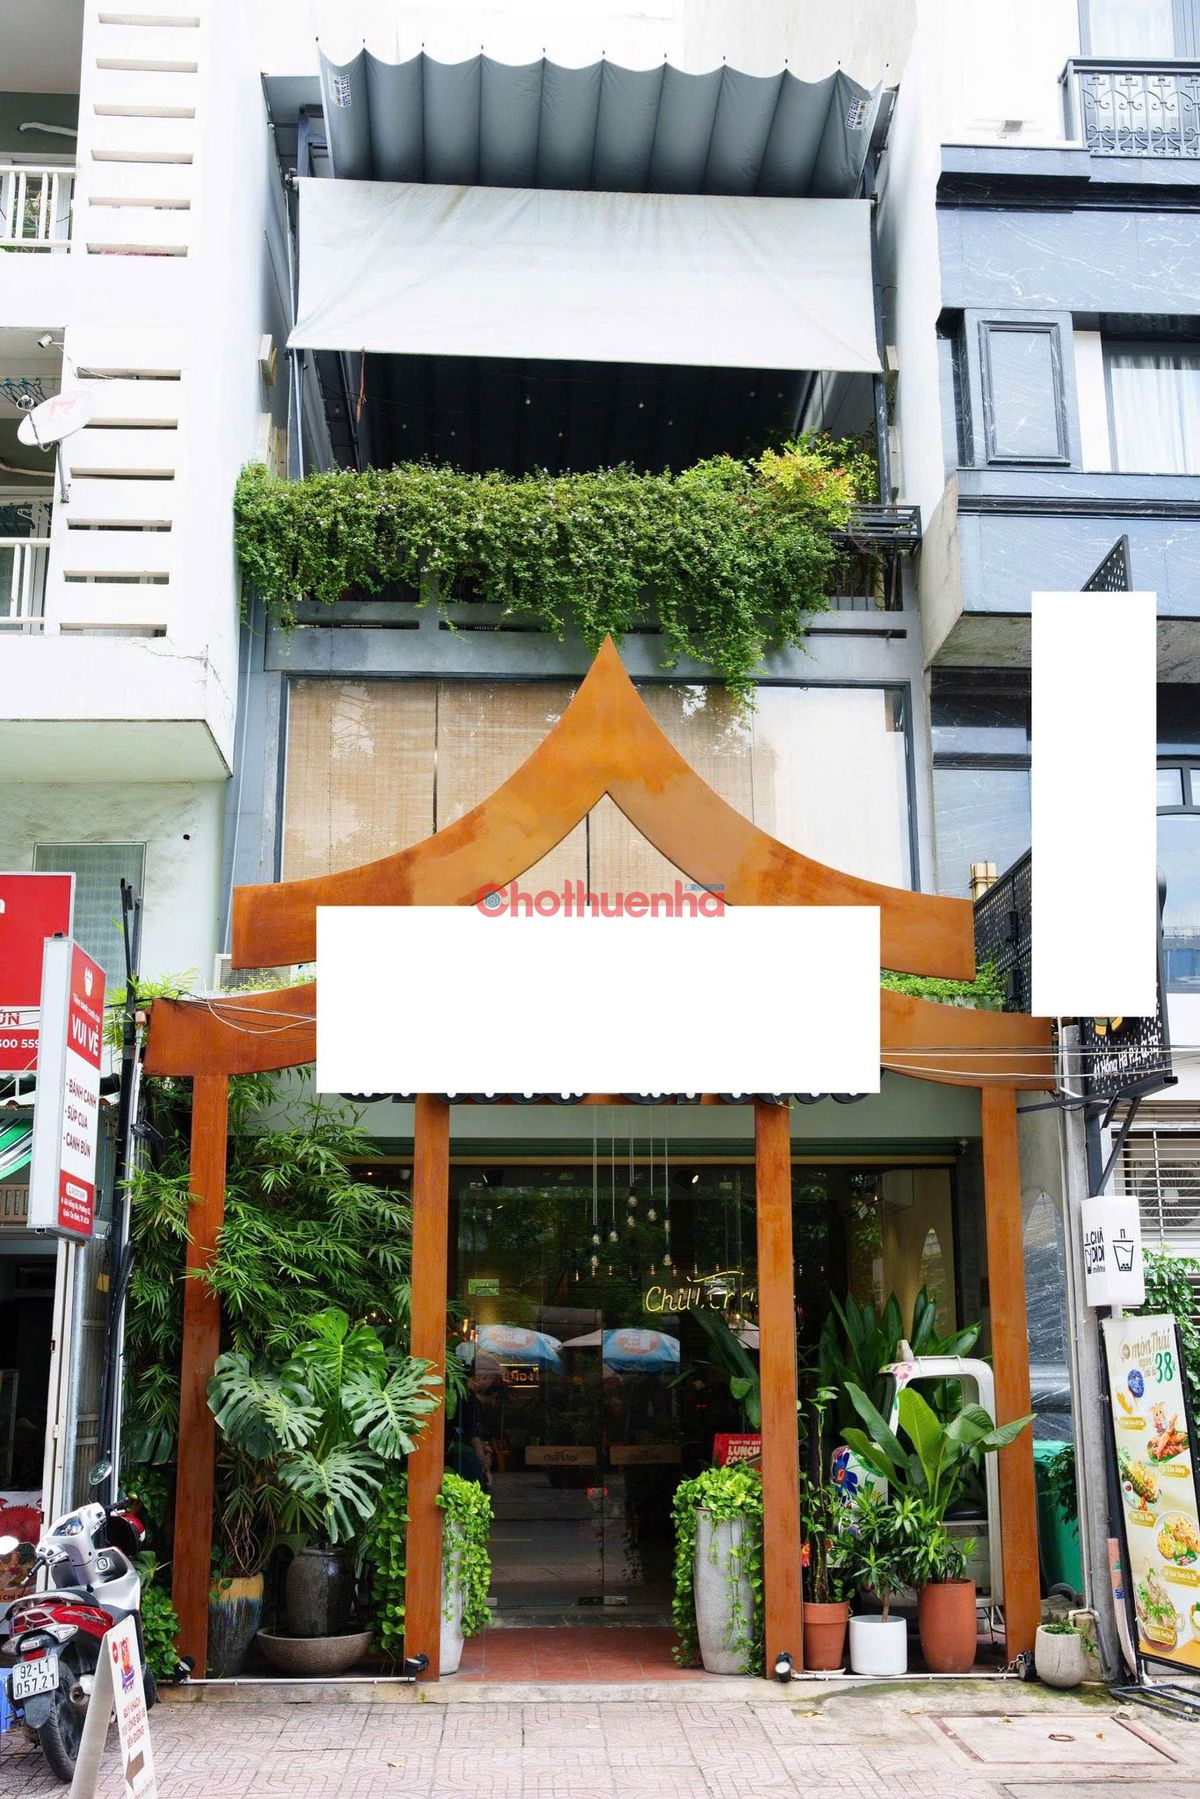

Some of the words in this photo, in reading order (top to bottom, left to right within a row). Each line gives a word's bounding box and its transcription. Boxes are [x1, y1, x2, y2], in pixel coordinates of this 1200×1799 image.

[72, 1013, 87, 1047] VUI
[88, 1024, 99, 1057] VẺ
[69, 1078, 84, 1100] BÁNH
[83, 1089, 97, 1109] CANH
[67, 1104, 78, 1122] SÚP
[66, 1132, 80, 1152] CANH
[80, 1139, 92, 1157] BÚN
[728, 1445, 761, 1457] LUNCH
[20, 1659, 50, 1679] 92-L1
[16, 1673, 55, 1696] 057.21
